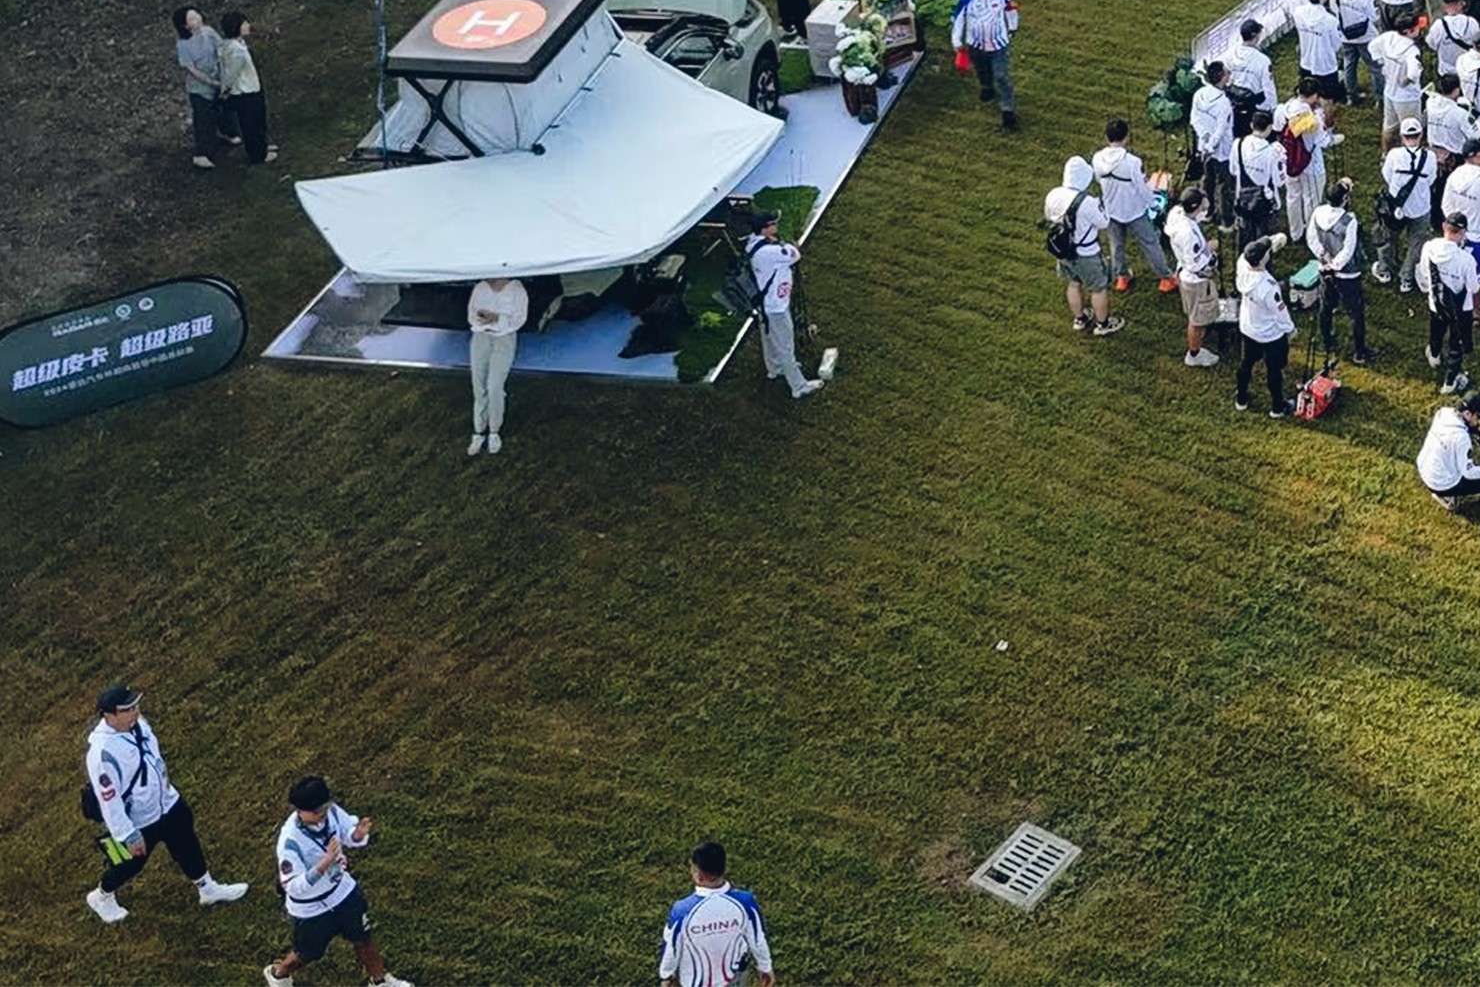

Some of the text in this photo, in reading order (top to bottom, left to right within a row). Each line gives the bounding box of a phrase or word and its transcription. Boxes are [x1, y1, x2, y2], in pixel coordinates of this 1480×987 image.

[12, 346, 110, 392] 超级皮卡
[119, 314, 214, 358] 超级路亚
[690, 918, 740, 934] CHINA
